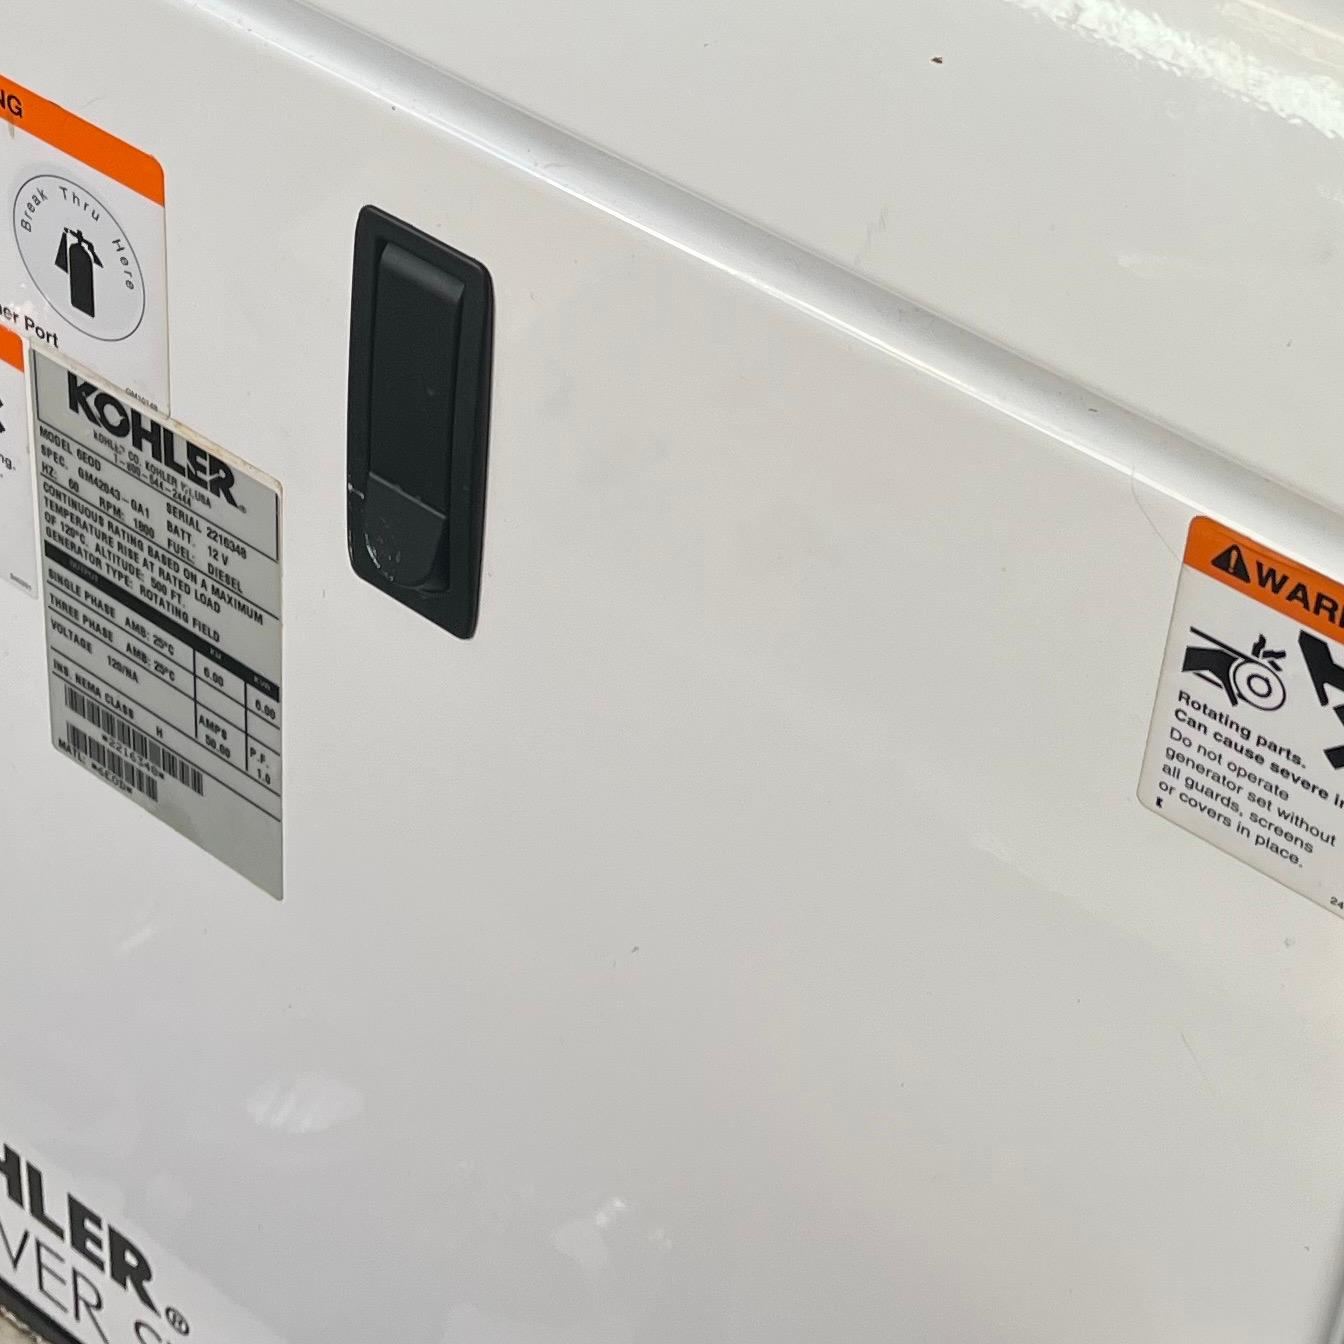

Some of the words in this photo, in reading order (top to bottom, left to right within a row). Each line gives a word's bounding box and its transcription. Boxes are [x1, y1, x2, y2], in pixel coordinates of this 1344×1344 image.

[21, 187, 48, 233] Break
[59, 187, 100, 222] Thru
[112, 239, 135, 290] Here
[24, 315, 58, 348] Port
[39, 425, 72, 454] MODEL
[43, 481, 104, 527] CONTINUOUS
[107, 520, 143, 551] RATING
[147, 545, 179, 573] BASED
[183, 567, 197, 584] ON
[200, 578, 207, 591] A
[211, 584, 262, 625] MAXIMUM
[44, 495, 113, 548] TEMPERATURE
[117, 541, 138, 563] RISE
[142, 557, 154, 572] AT
[158, 566, 190, 595] RATED
[194, 589, 220, 613] LOAD
[166, 502, 201, 532] SERIAL
[45, 526, 102, 569] GENERATOR
[139, 584, 188, 623] ROTATING
[192, 617, 219, 642] FIELD
[207, 562, 242, 593] DIESEL
[1169, 726, 1192, 747] Do
[1196, 744, 1222, 765] not
[1227, 761, 1288, 800] operate
[1174, 708, 1207, 734] Can
[1213, 731, 1264, 764] cause
[1270, 762, 1328, 799] severe
[1178, 690, 1251, 740] Rotating
[1255, 735, 1305, 768] parts.
[1158, 781, 1174, 794] or
[1179, 792, 1231, 826] covers
[1236, 821, 1250, 837] in
[1254, 834, 1302, 867] place.
[1162, 763, 1180, 779] all
[1184, 776, 1243, 817] guards,
[1249, 812, 1313, 853] screens
[1165, 747, 1242, 793] generator
[1247, 791, 1271, 811] set
[1277, 807, 1335, 846] without
